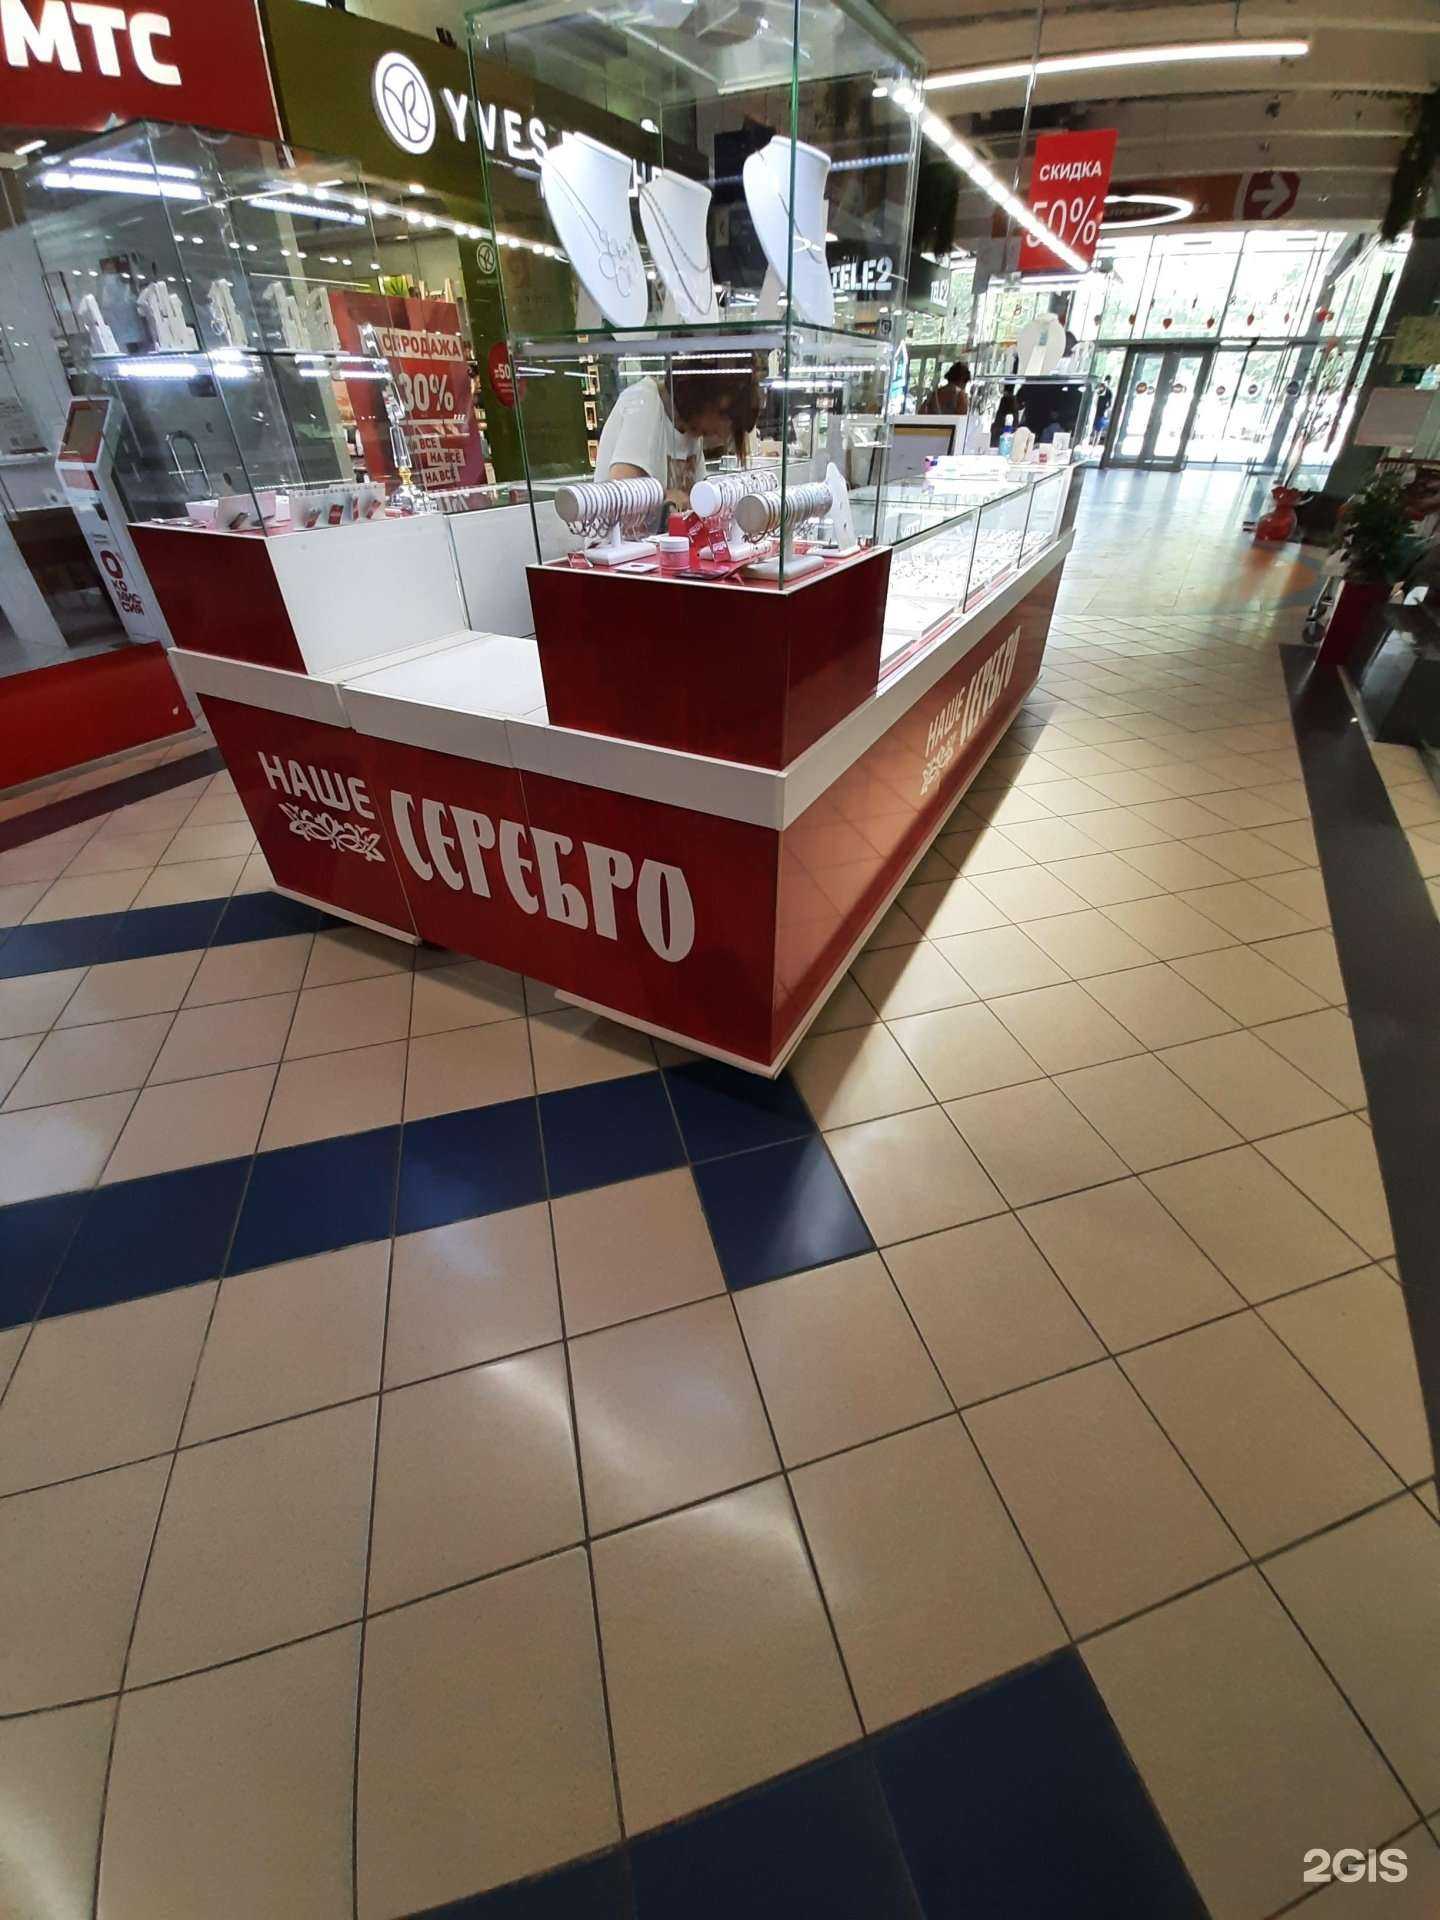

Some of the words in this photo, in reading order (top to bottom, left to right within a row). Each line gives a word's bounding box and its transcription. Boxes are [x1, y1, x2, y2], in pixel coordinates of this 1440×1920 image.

[0, 0, 182, 86] МТС
[441, 87, 549, 166] YVES
[1039, 160, 1103, 182] СКИДКА
[830, 256, 893, 291] TELE2
[372, 333, 461, 358] СПРОДАЖА
[425, 472, 438, 484] НА
[924, 686, 967, 758] НАШЕ
[959, 624, 1022, 746] СЕРЕБРО
[258, 751, 376, 820] НАШЕ
[390, 789, 696, 963] СЕРЕБРО
